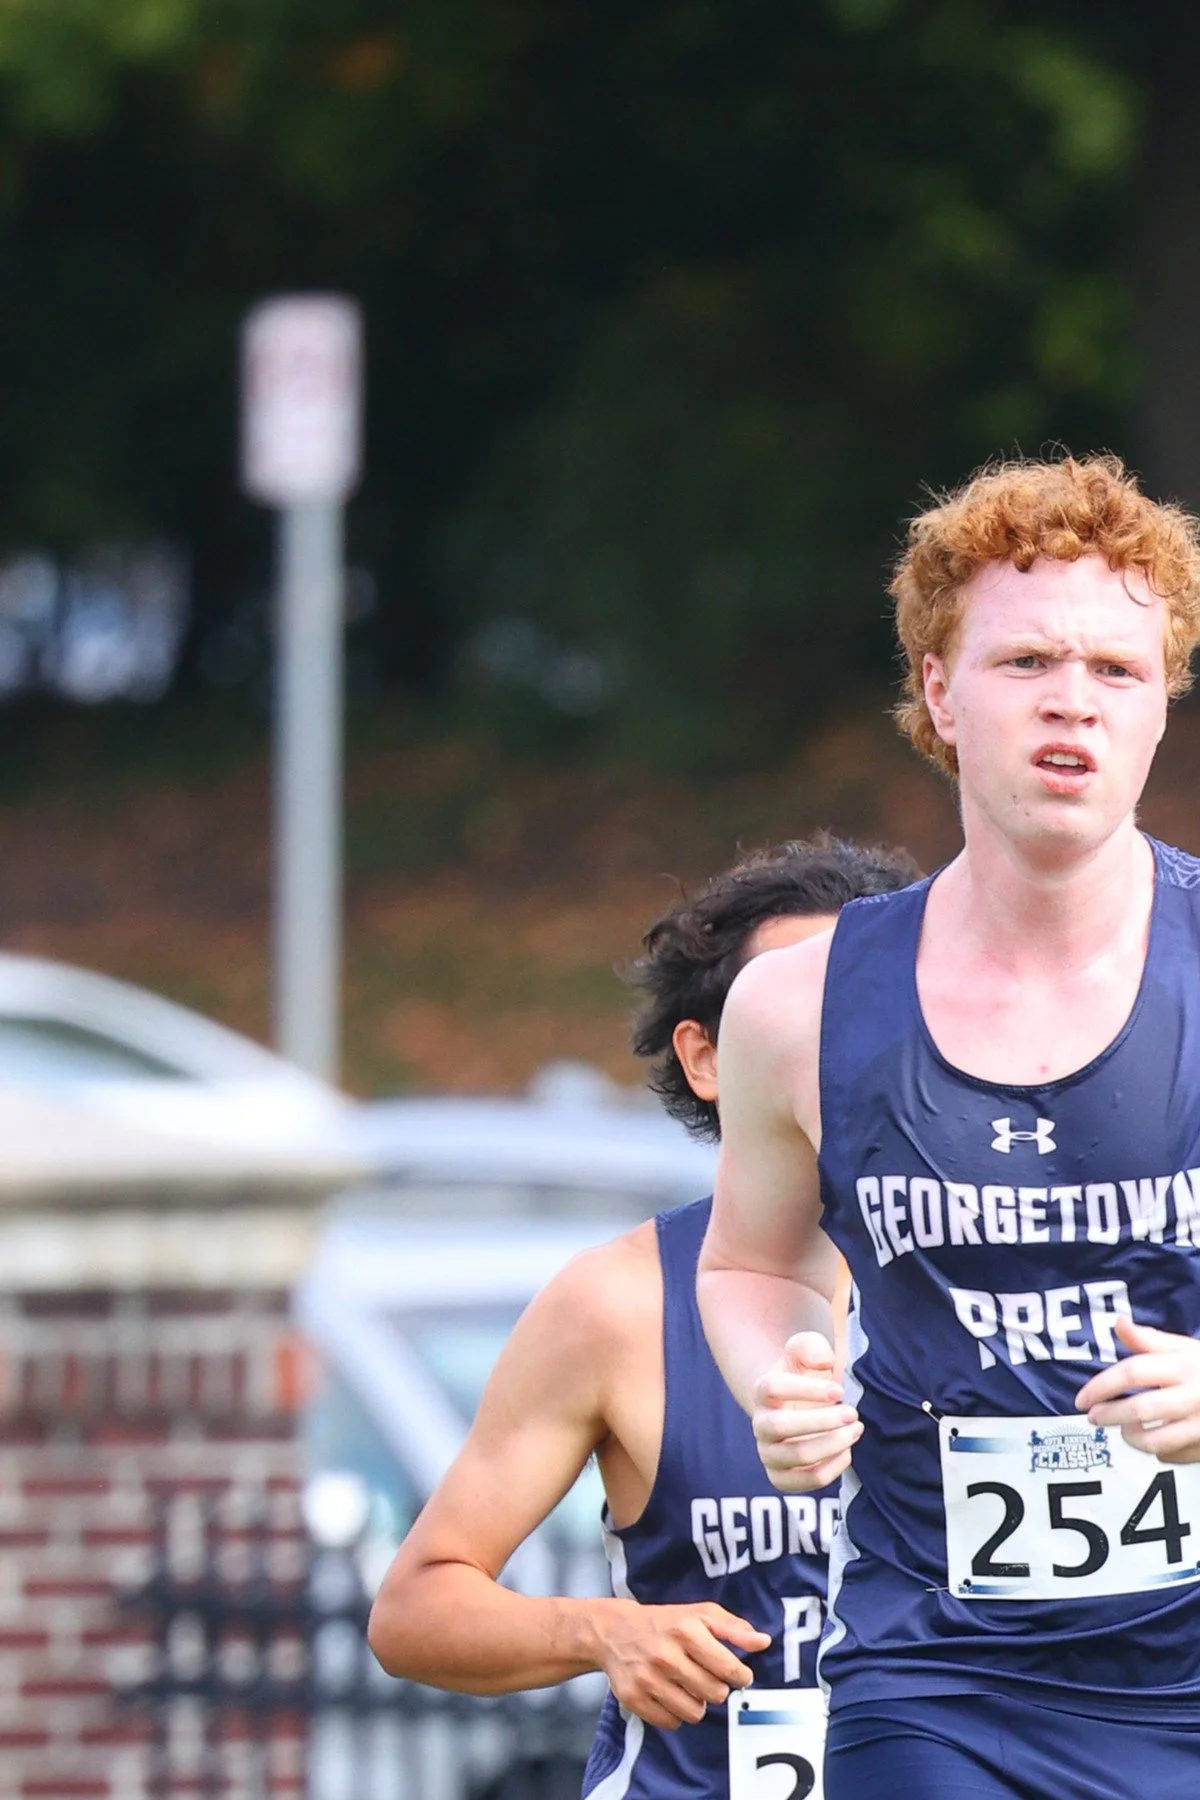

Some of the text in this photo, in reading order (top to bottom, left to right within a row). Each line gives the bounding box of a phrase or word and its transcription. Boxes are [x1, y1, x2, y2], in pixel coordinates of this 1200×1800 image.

[949, 1280, 1133, 1370] PREP
[1038, 1449, 1104, 1468] CLASSIC
[966, 1470, 1191, 1578] 254
